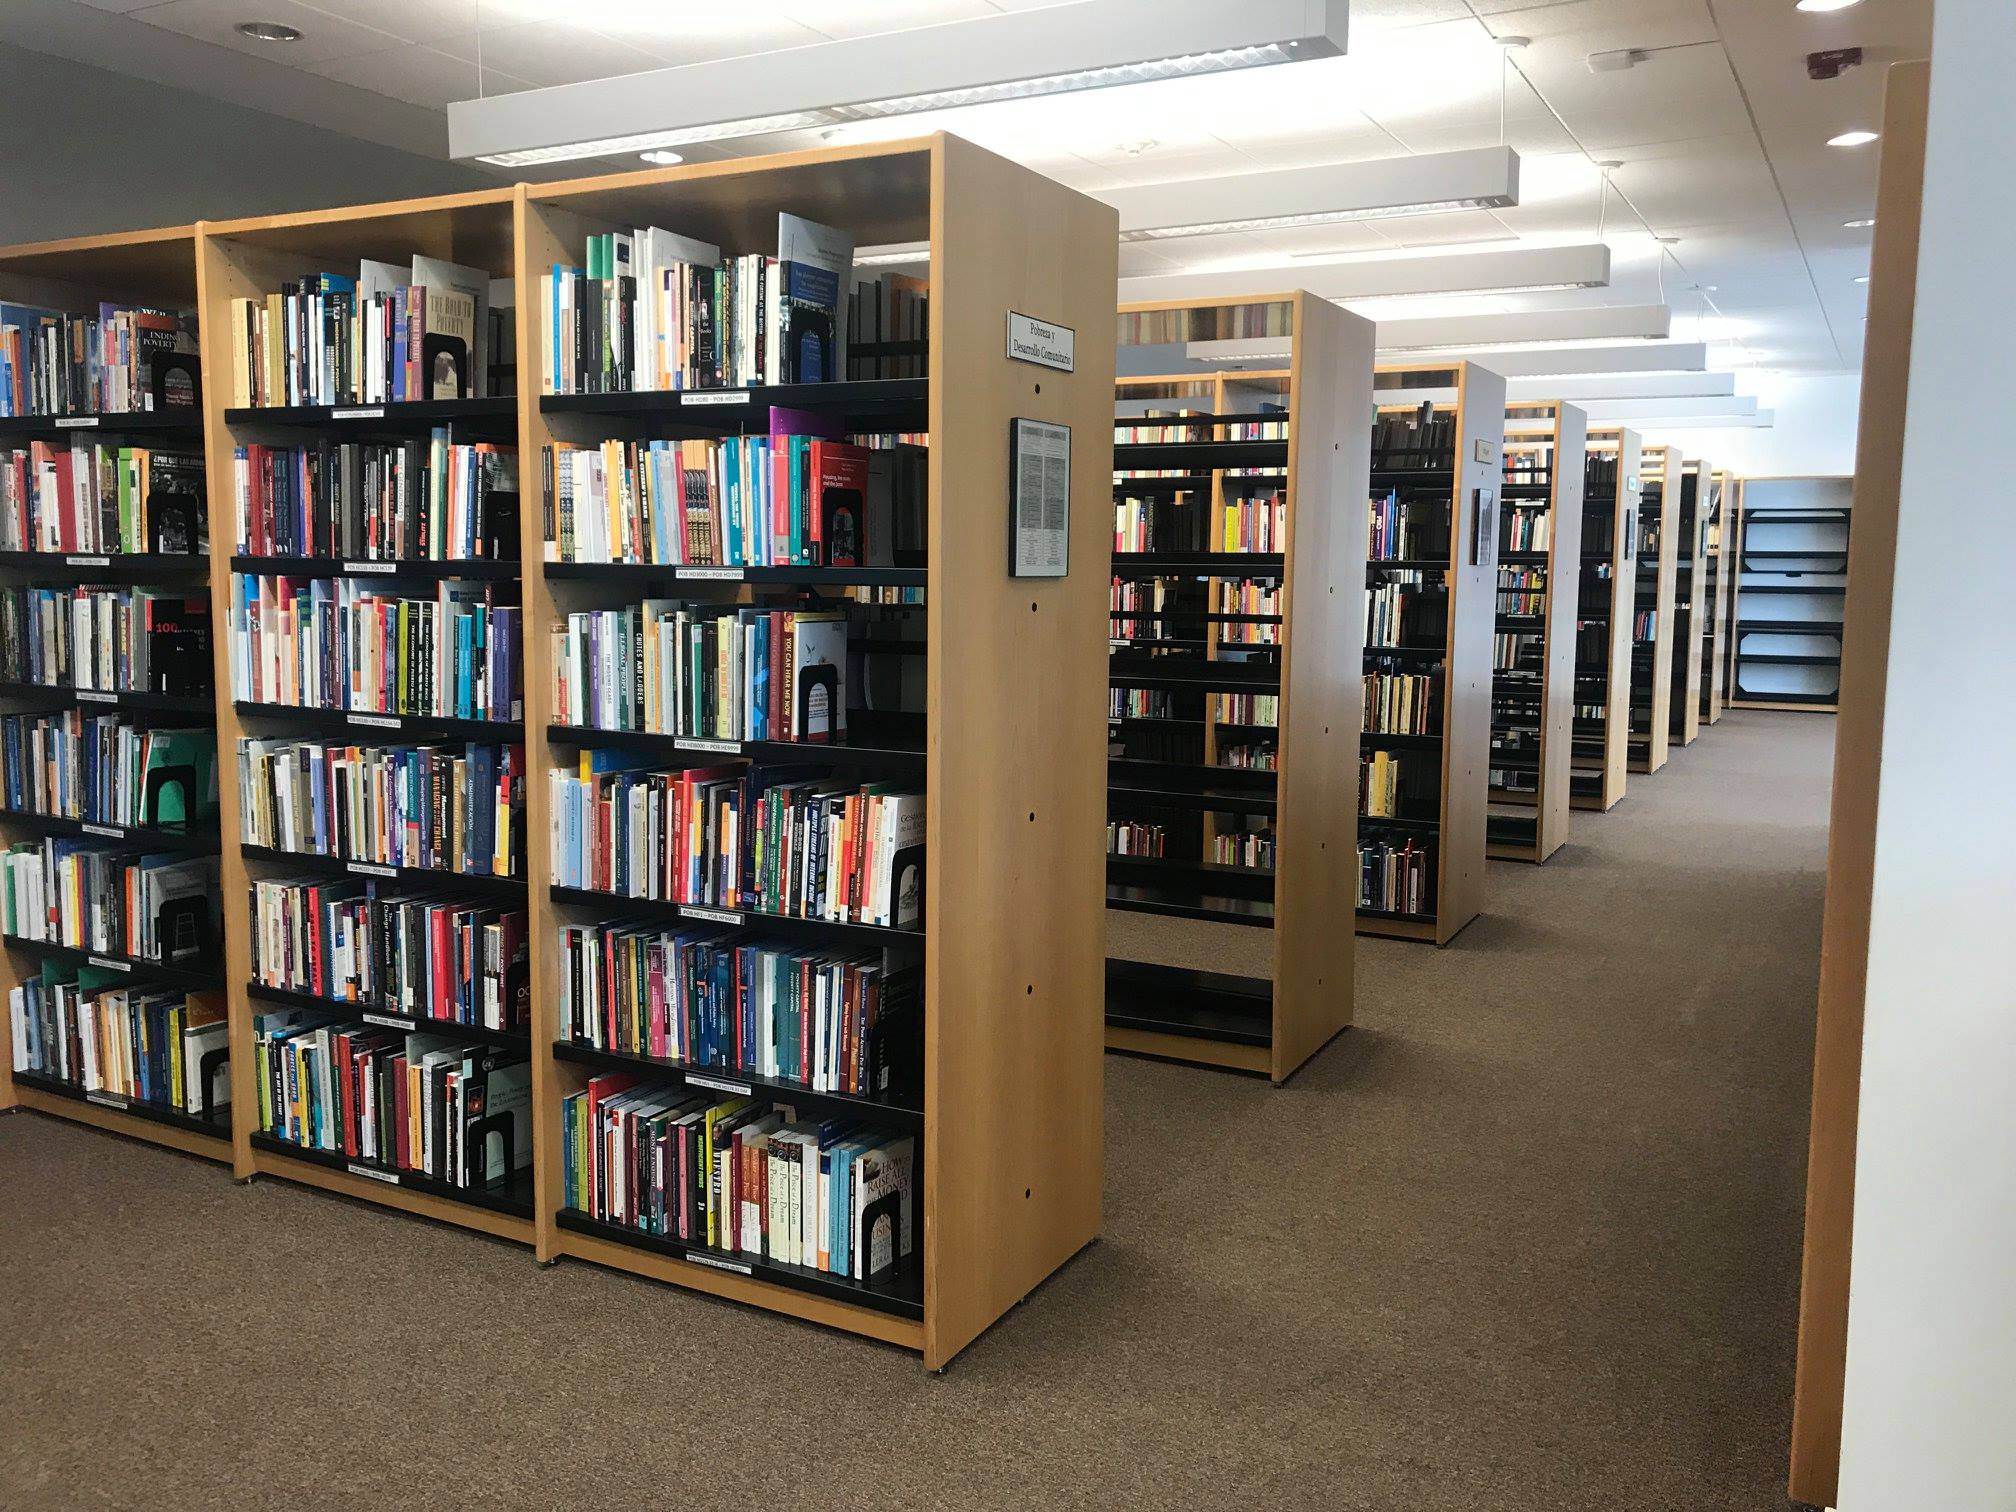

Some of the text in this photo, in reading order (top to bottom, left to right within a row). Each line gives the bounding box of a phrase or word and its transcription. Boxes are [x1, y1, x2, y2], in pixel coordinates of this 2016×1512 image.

[1030, 322, 1056, 343] Pobreza y
[143, 338, 177, 348] POVERTY
[1014, 339, 1072, 366] Desarrollo Comunitario
[784, 653, 792, 668] CAN
[784, 690, 791, 699] ME
[810, 853, 816, 861] OF
[808, 861, 816, 884] INTERNET
[769, 1168, 777, 1185] Price
[779, 1172, 787, 1190] Price
[791, 1174, 799, 1192] Price
[770, 1197, 778, 1219] Dream
[791, 1202, 799, 1225] Dream
